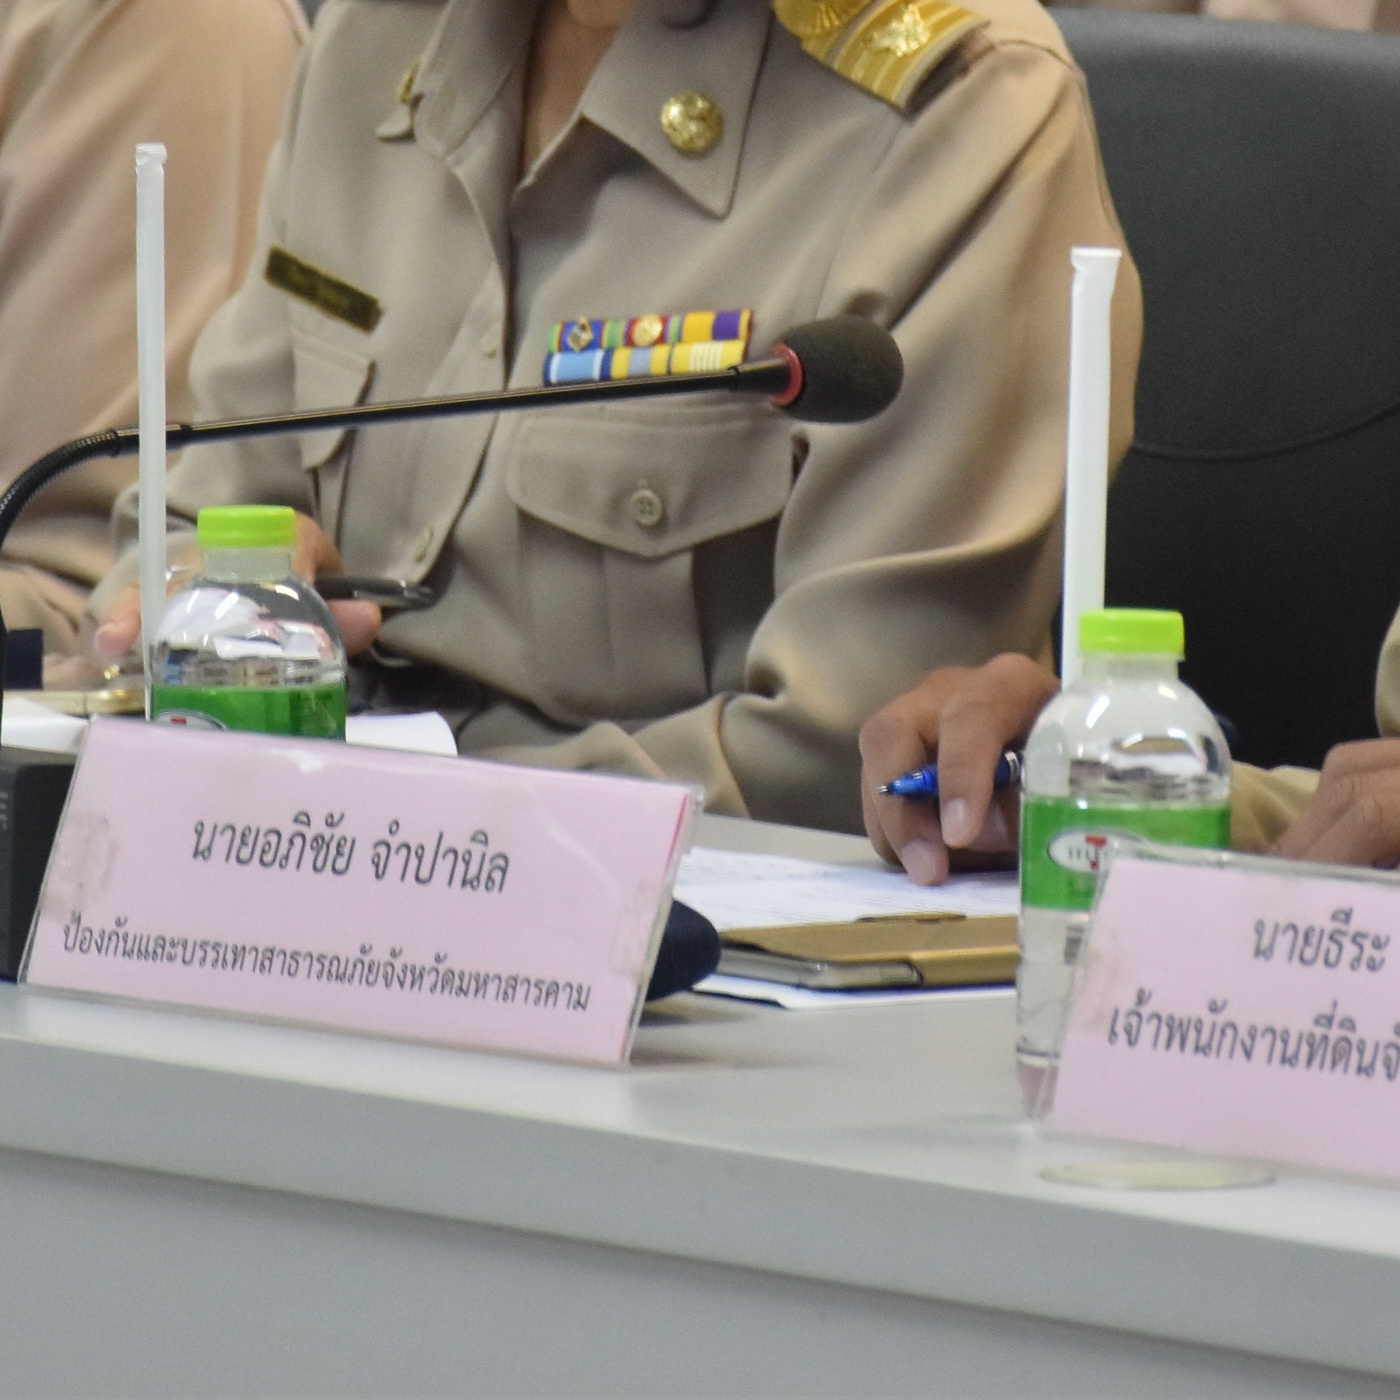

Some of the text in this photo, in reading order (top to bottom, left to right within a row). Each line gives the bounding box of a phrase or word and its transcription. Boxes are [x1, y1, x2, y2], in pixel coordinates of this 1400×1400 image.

[192, 810, 511, 894] นายอภิชัย จำปานิล
[63, 912, 593, 1012] ป้องกันและบรรเทาสาธารณภัยจังหวัดมหาสารคาม
[1253, 906, 1392, 973] นายธีระ
